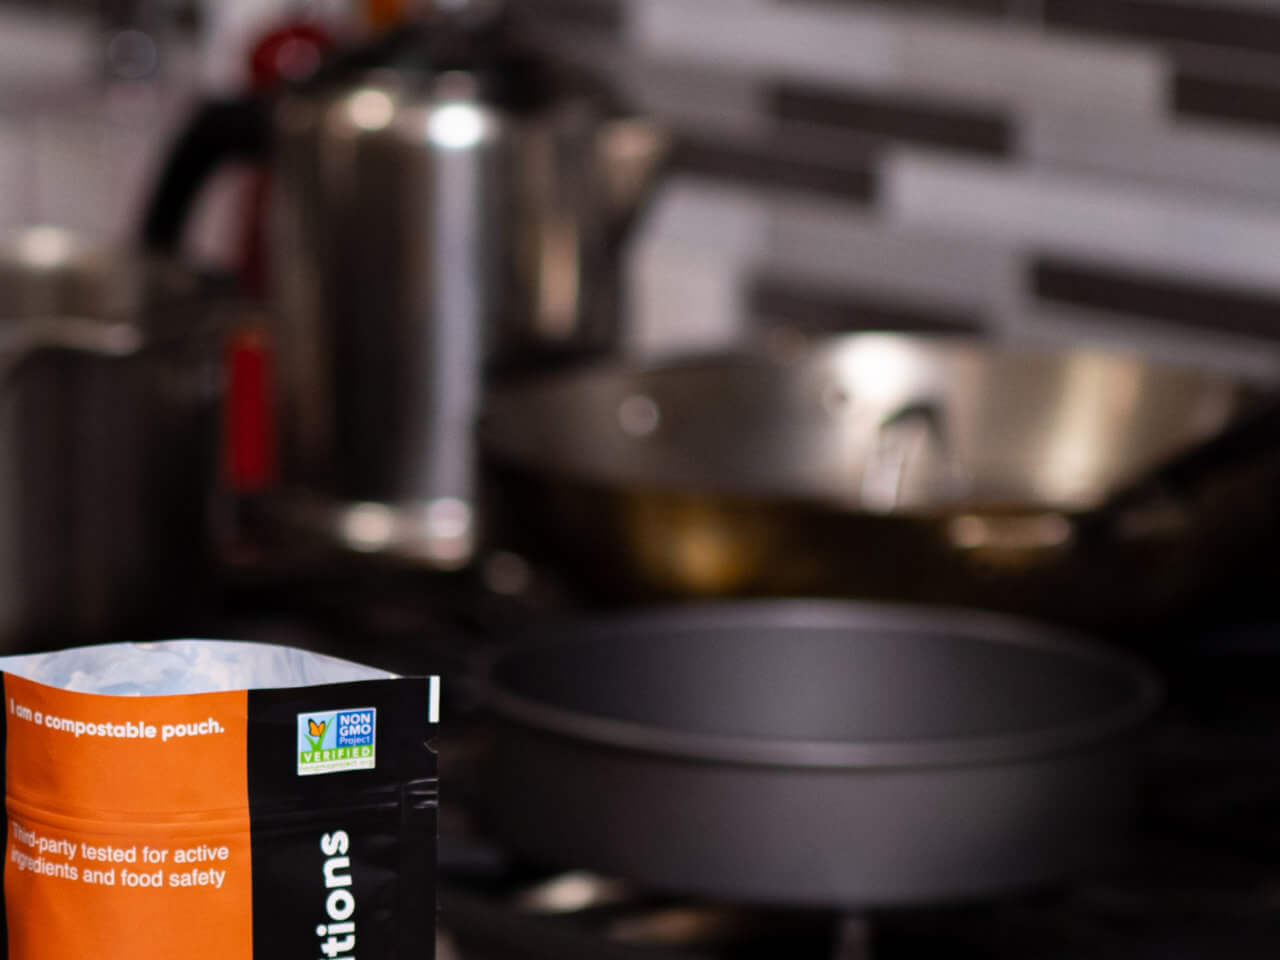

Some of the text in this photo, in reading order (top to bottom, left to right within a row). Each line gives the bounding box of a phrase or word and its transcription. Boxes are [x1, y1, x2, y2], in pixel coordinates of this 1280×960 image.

[10, 698, 225, 742] I am a compostable pouch.
[340, 713, 371, 725] NON
[340, 724, 371, 736] GMO
[340, 735, 370, 745] Project
[304, 747, 370, 762] VERIFIED
[81, 842, 137, 863] tested
[142, 845, 169, 864] for
[174, 843, 229, 864] active
[82, 869, 115, 886] and
[121, 868, 163, 887] food
[169, 867, 226, 889] safety
